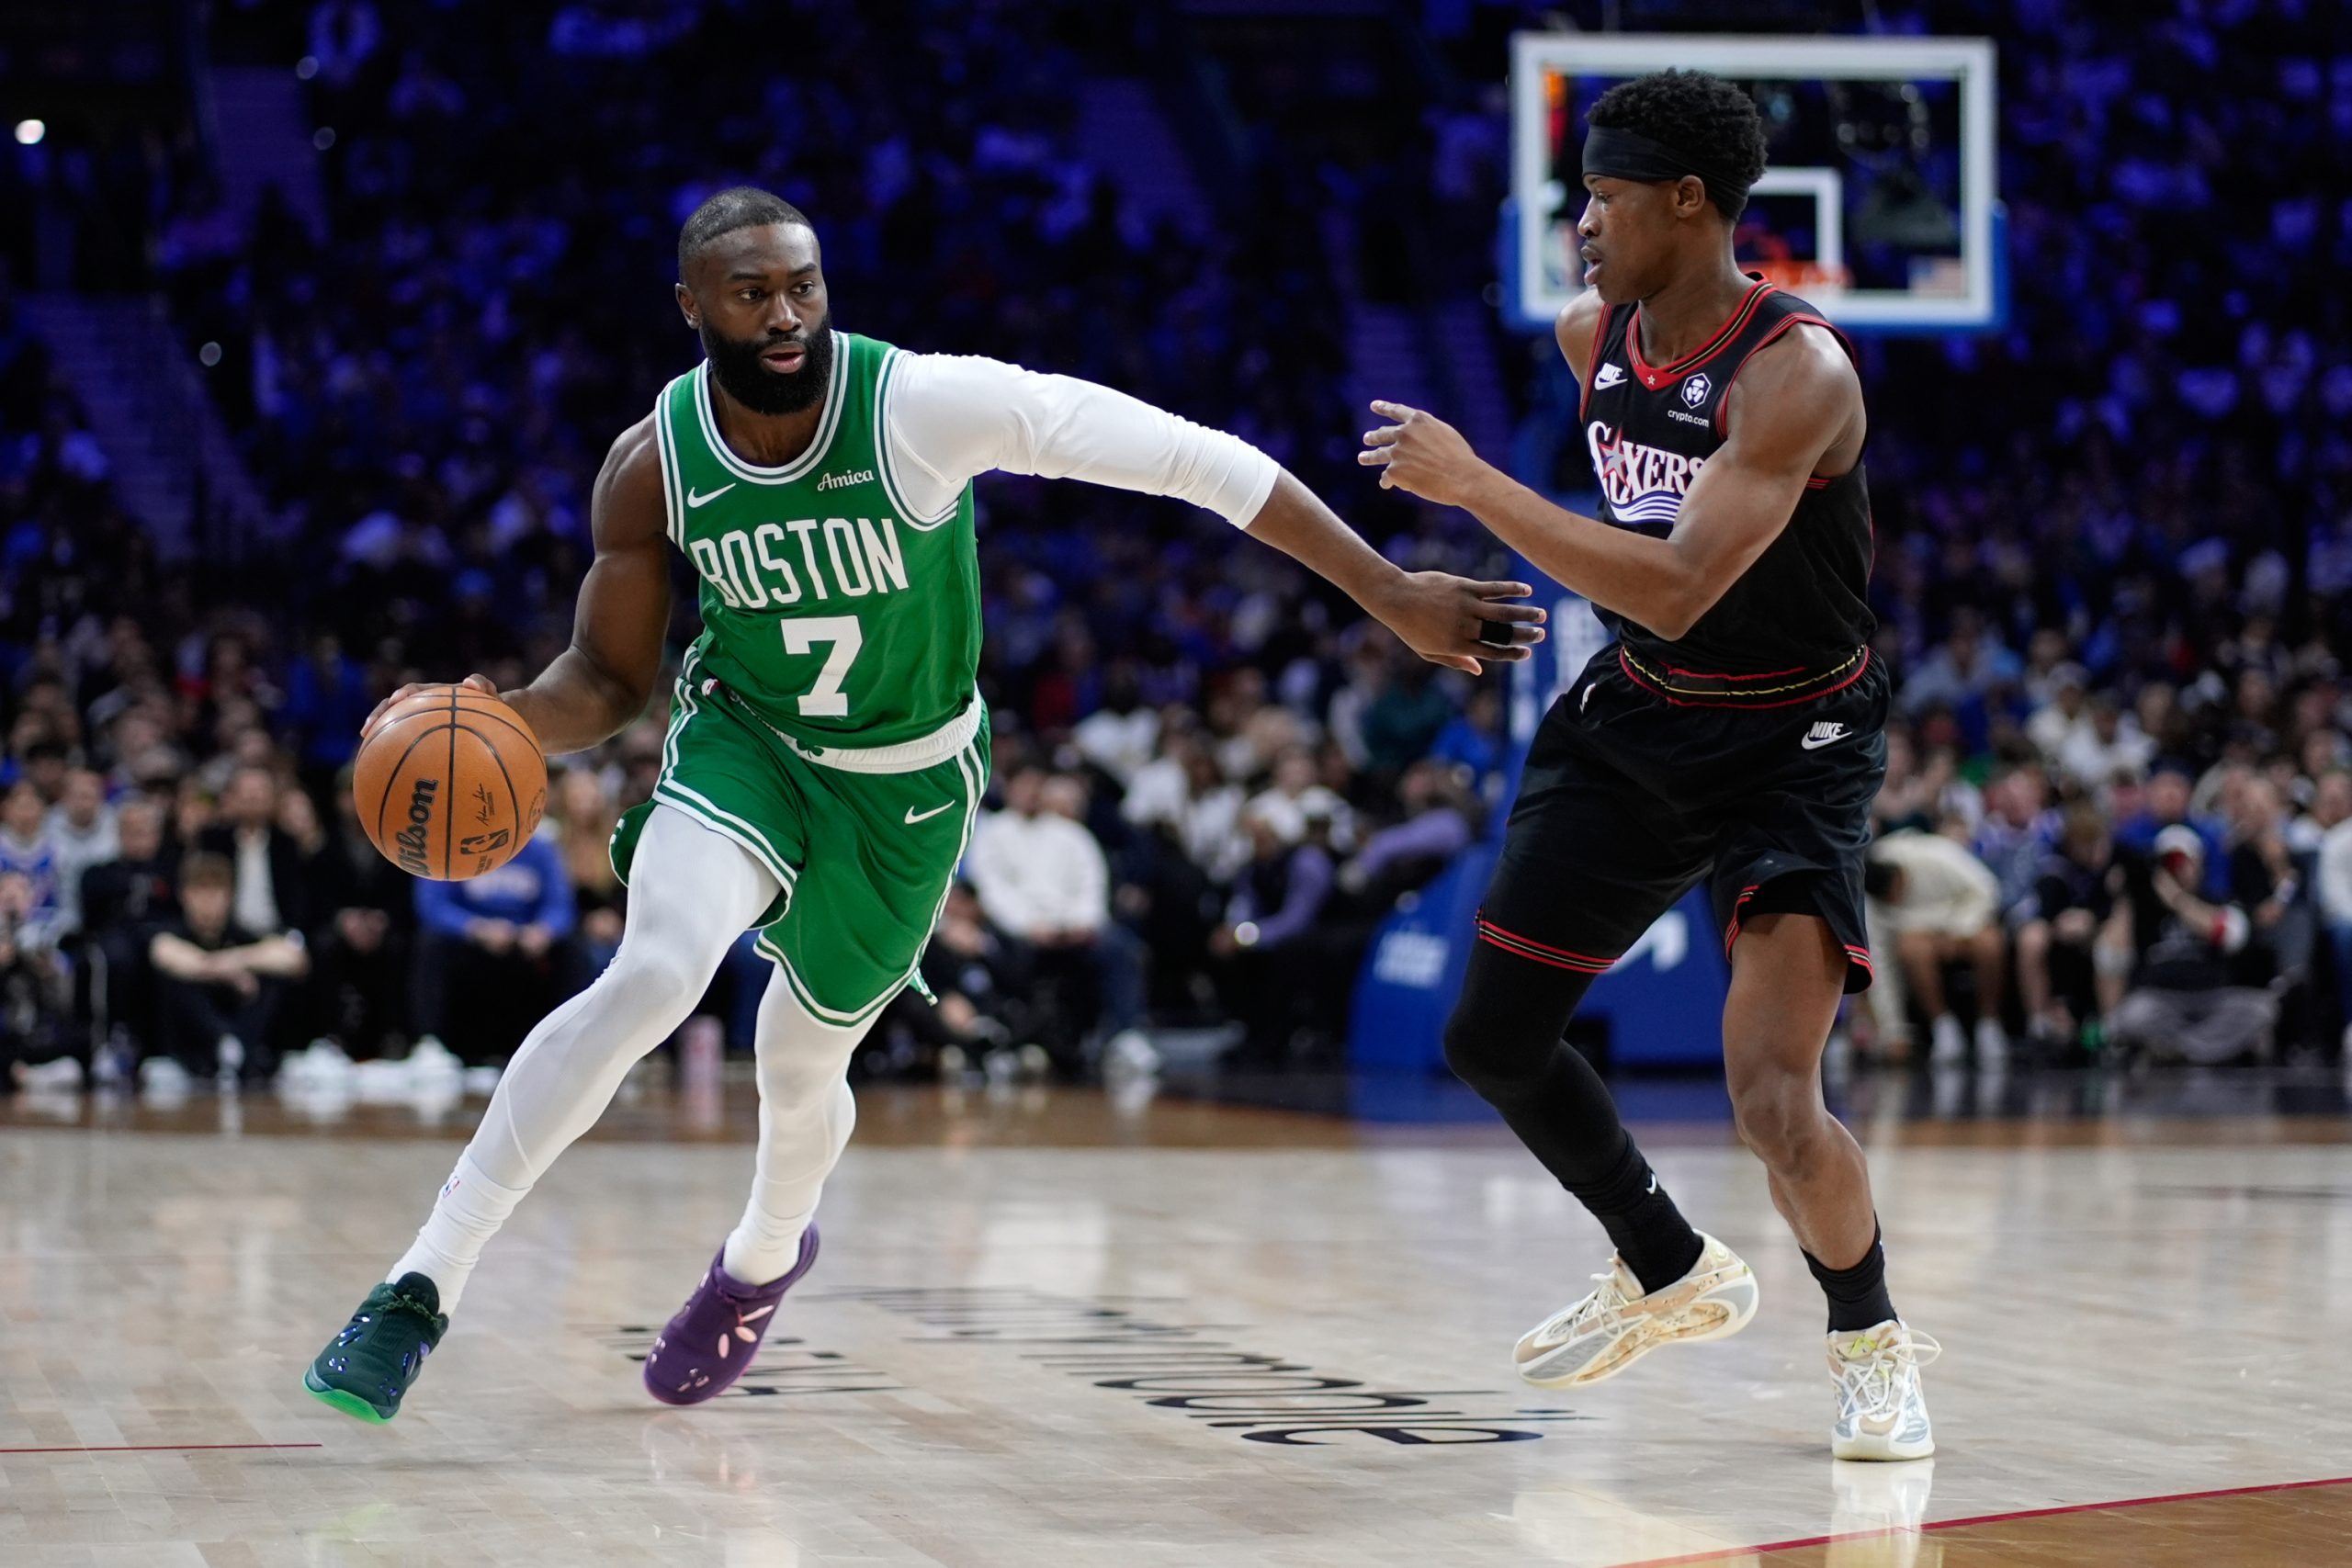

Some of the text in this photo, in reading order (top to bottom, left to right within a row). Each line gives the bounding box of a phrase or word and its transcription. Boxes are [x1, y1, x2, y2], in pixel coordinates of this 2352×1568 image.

[1668, 410, 1710, 428] crypto.com
[817, 468, 874, 491] Amica
[689, 517, 910, 609] BOSTON
[781, 615, 864, 716] 7
[1808, 721, 1844, 739] NIKE
[395, 779, 439, 876] Wilson
[1018, 1352, 1608, 1446] mobile
